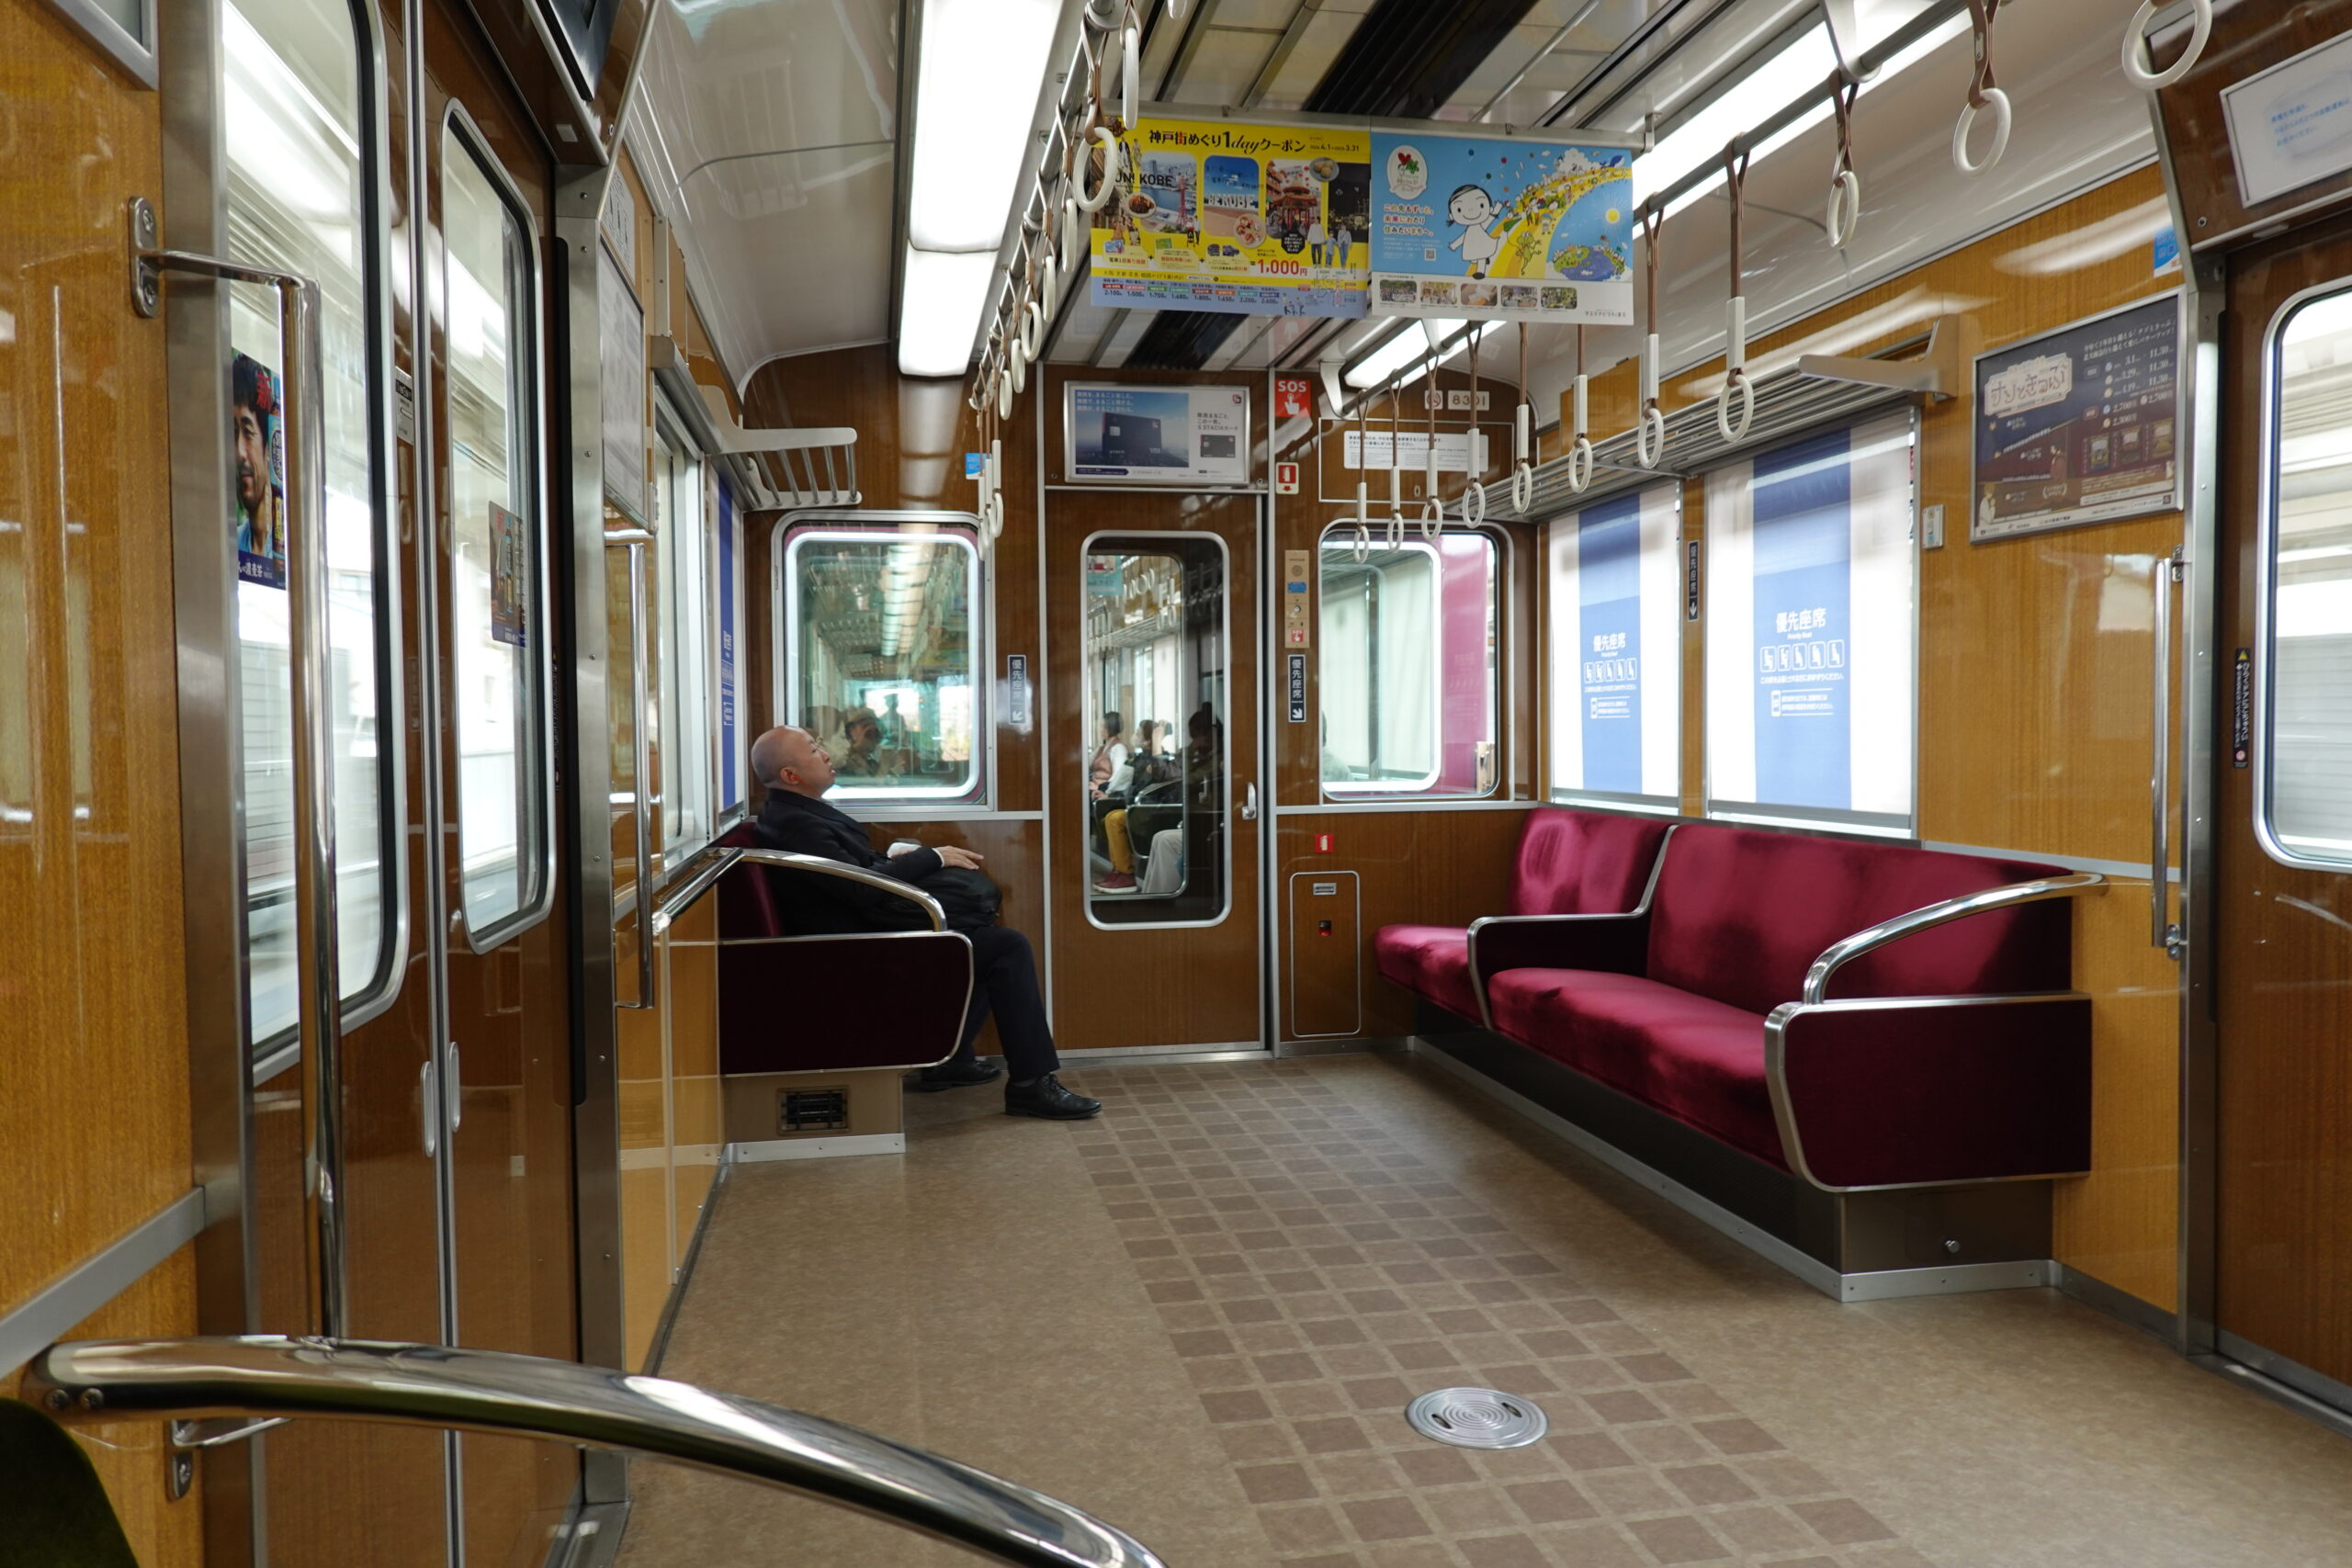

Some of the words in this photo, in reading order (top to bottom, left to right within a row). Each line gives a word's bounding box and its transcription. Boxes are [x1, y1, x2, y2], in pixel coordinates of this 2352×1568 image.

[1148, 130, 1306, 155] 神戸街めぐり1dayクーポン
[1384, 215, 1425, 225] 未来にわたり
[1258, 258, 1307, 276] 1,000円
[1278, 380, 1306, 392] SOS
[1775, 607, 1827, 633] 優先座席
[1593, 632, 1626, 652] 優先座席
[1292, 659, 1302, 699] 優先座席
